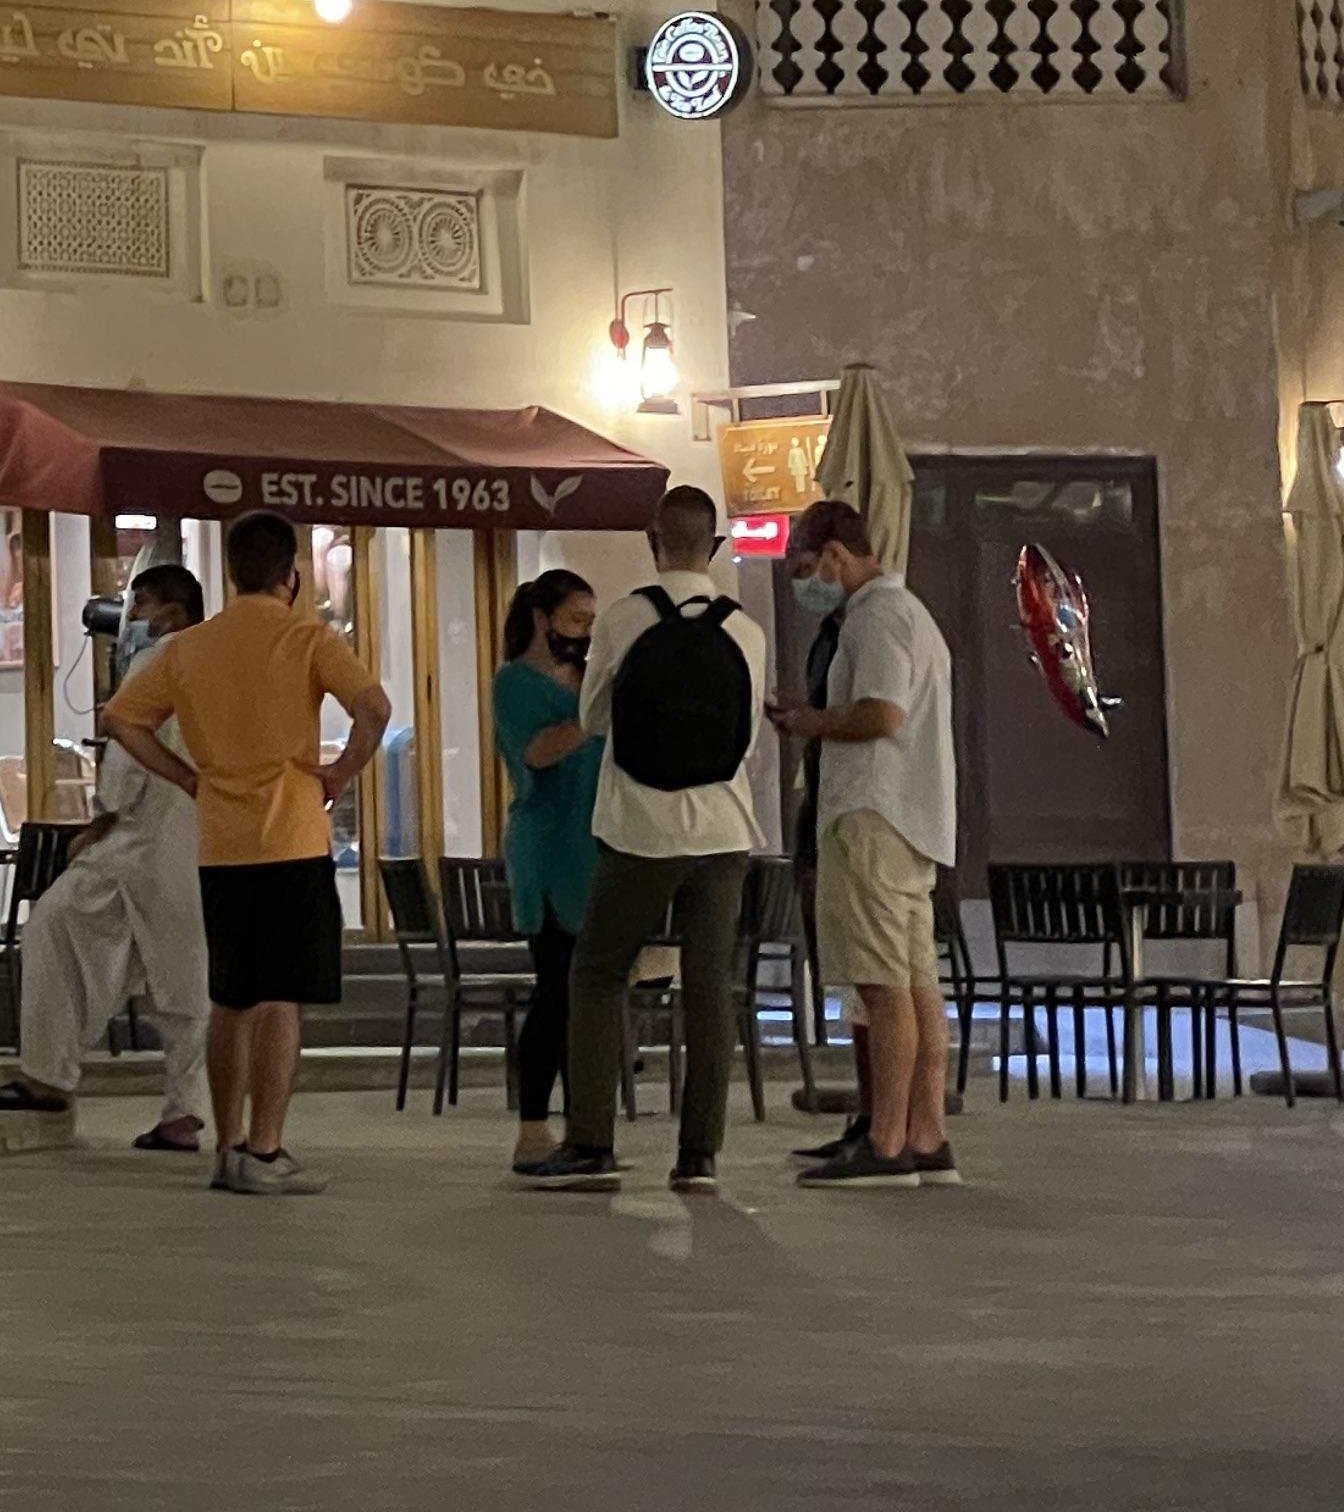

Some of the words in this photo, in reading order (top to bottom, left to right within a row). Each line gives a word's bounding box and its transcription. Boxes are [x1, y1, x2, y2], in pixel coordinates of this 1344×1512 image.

[261, 472, 324, 506] EST.
[330, 474, 425, 510] SINCE
[432, 477, 511, 511] 1963
